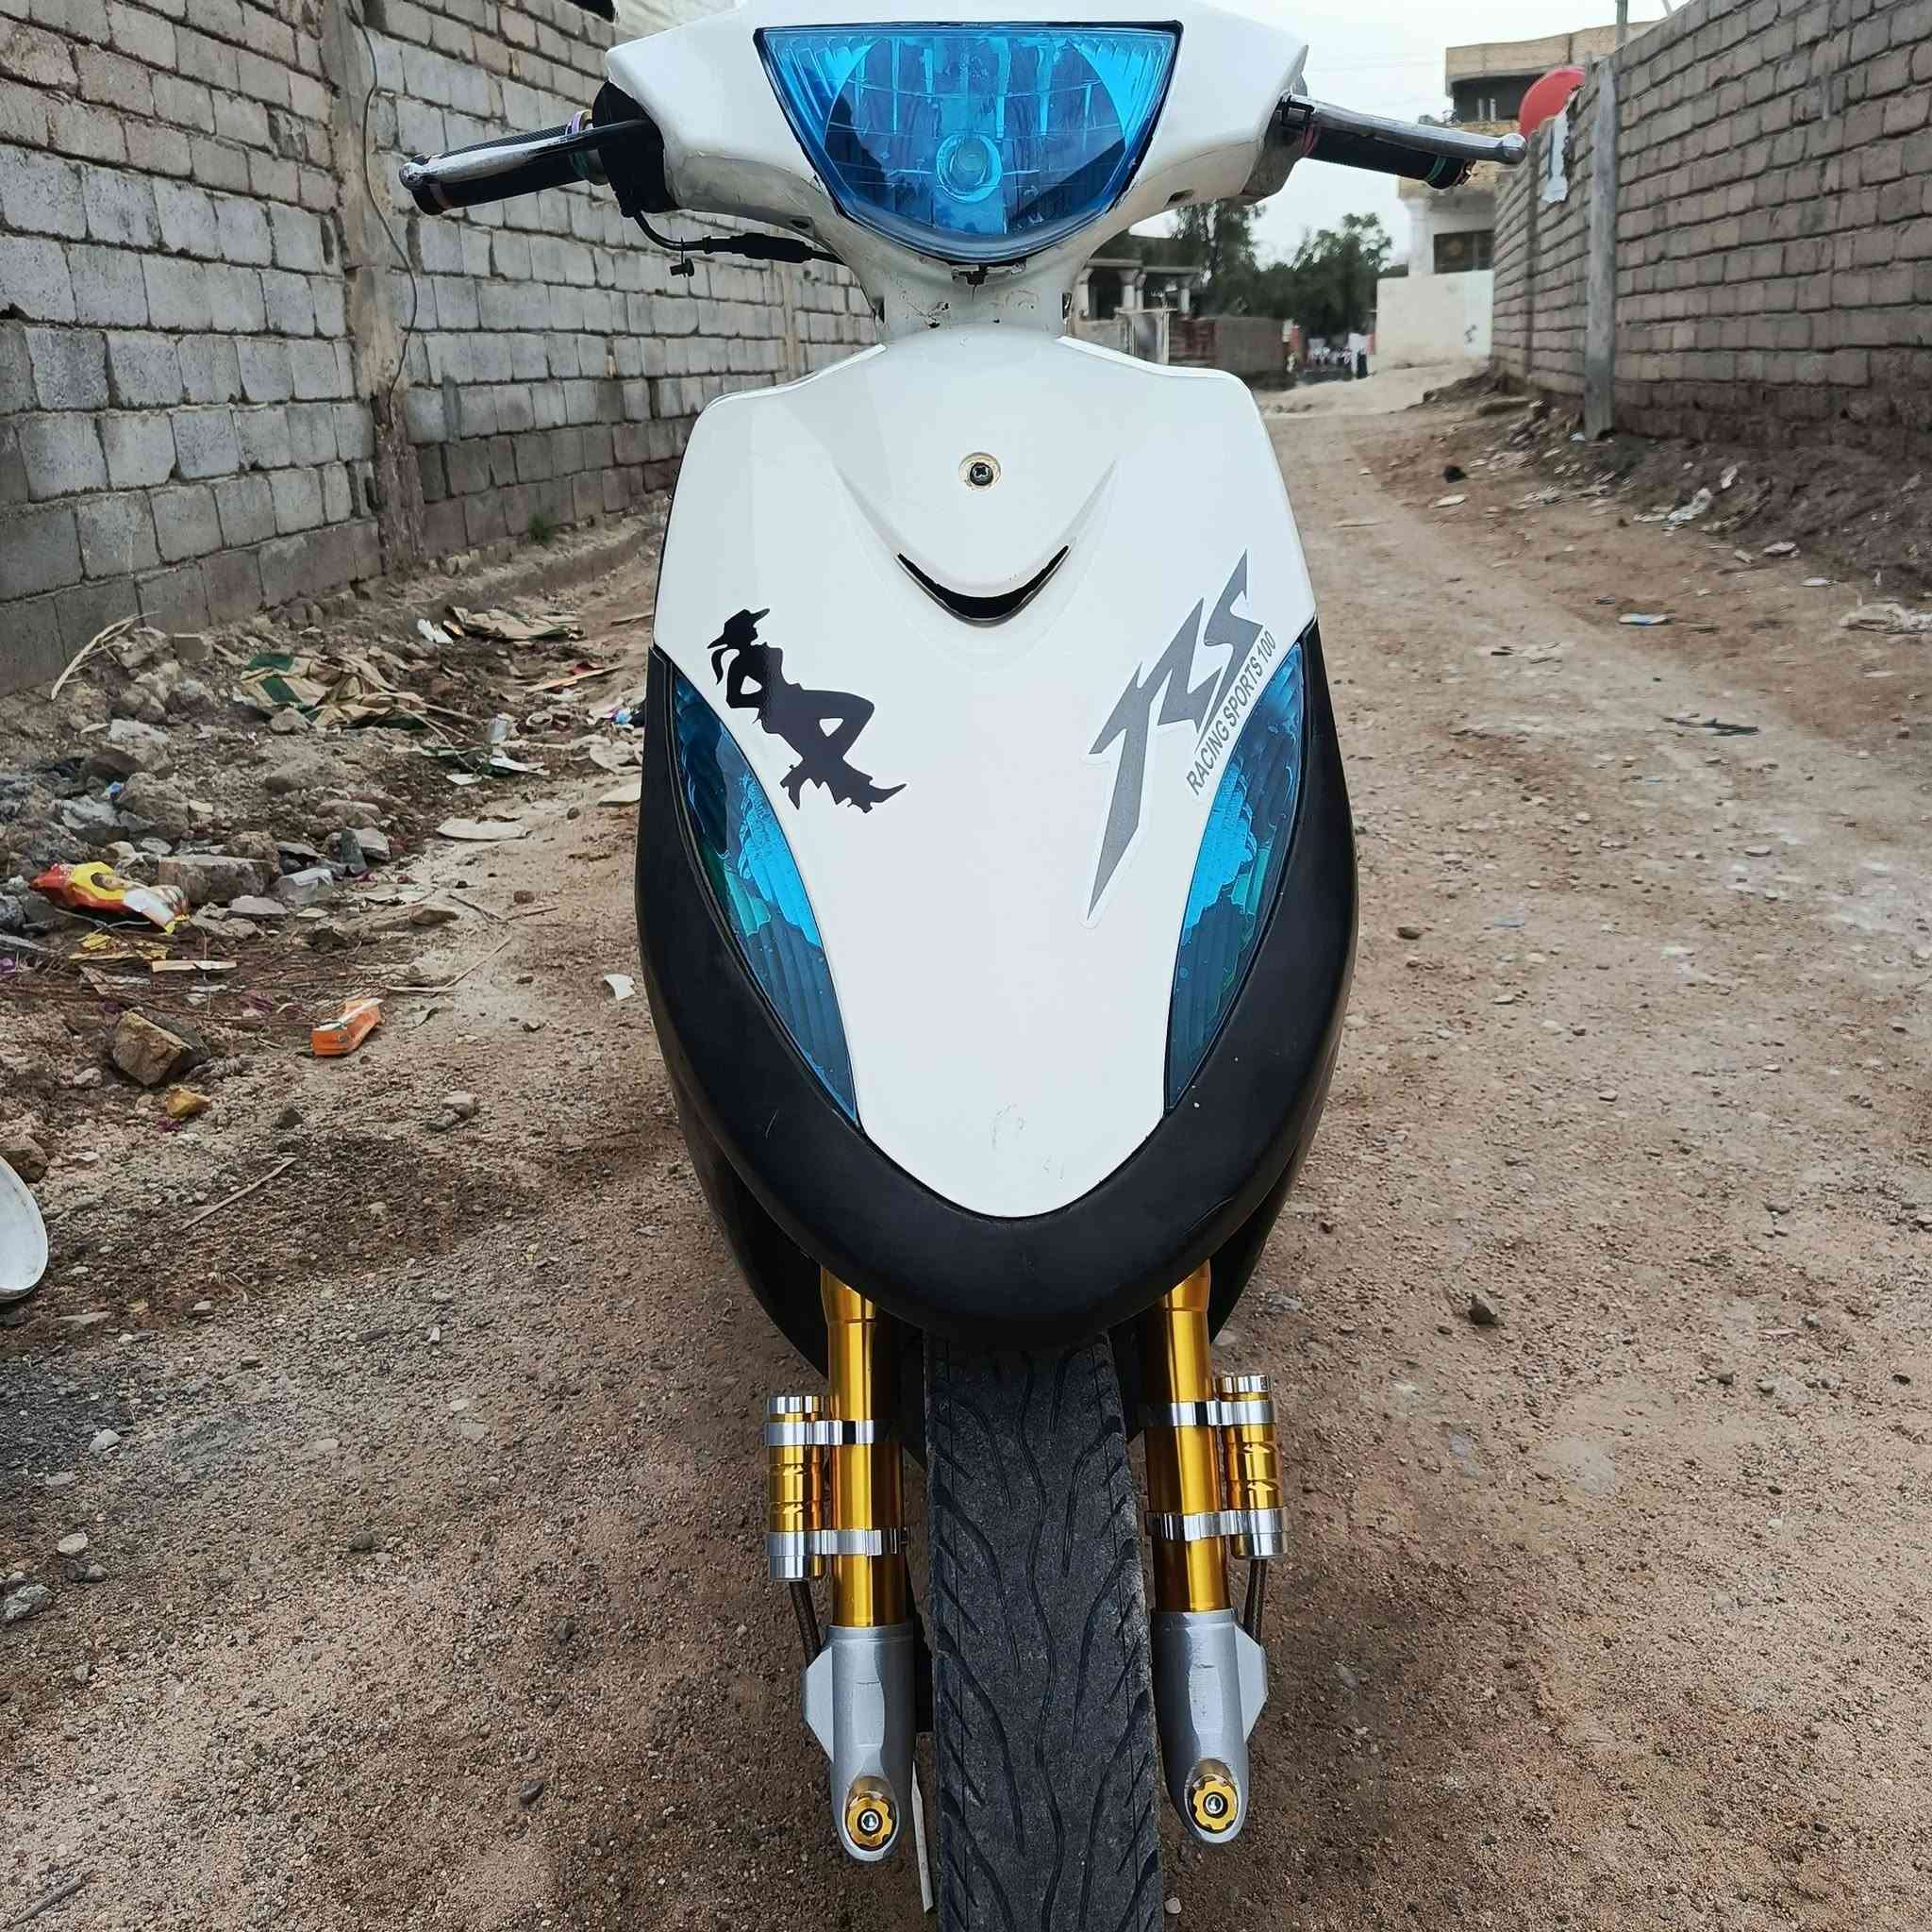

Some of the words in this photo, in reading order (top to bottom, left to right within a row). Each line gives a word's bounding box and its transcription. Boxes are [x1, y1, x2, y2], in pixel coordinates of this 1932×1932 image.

[1186, 720, 1230, 796] RACING
[1223, 656, 1264, 727] SPORTS
[1257, 630, 1276, 663] 100
